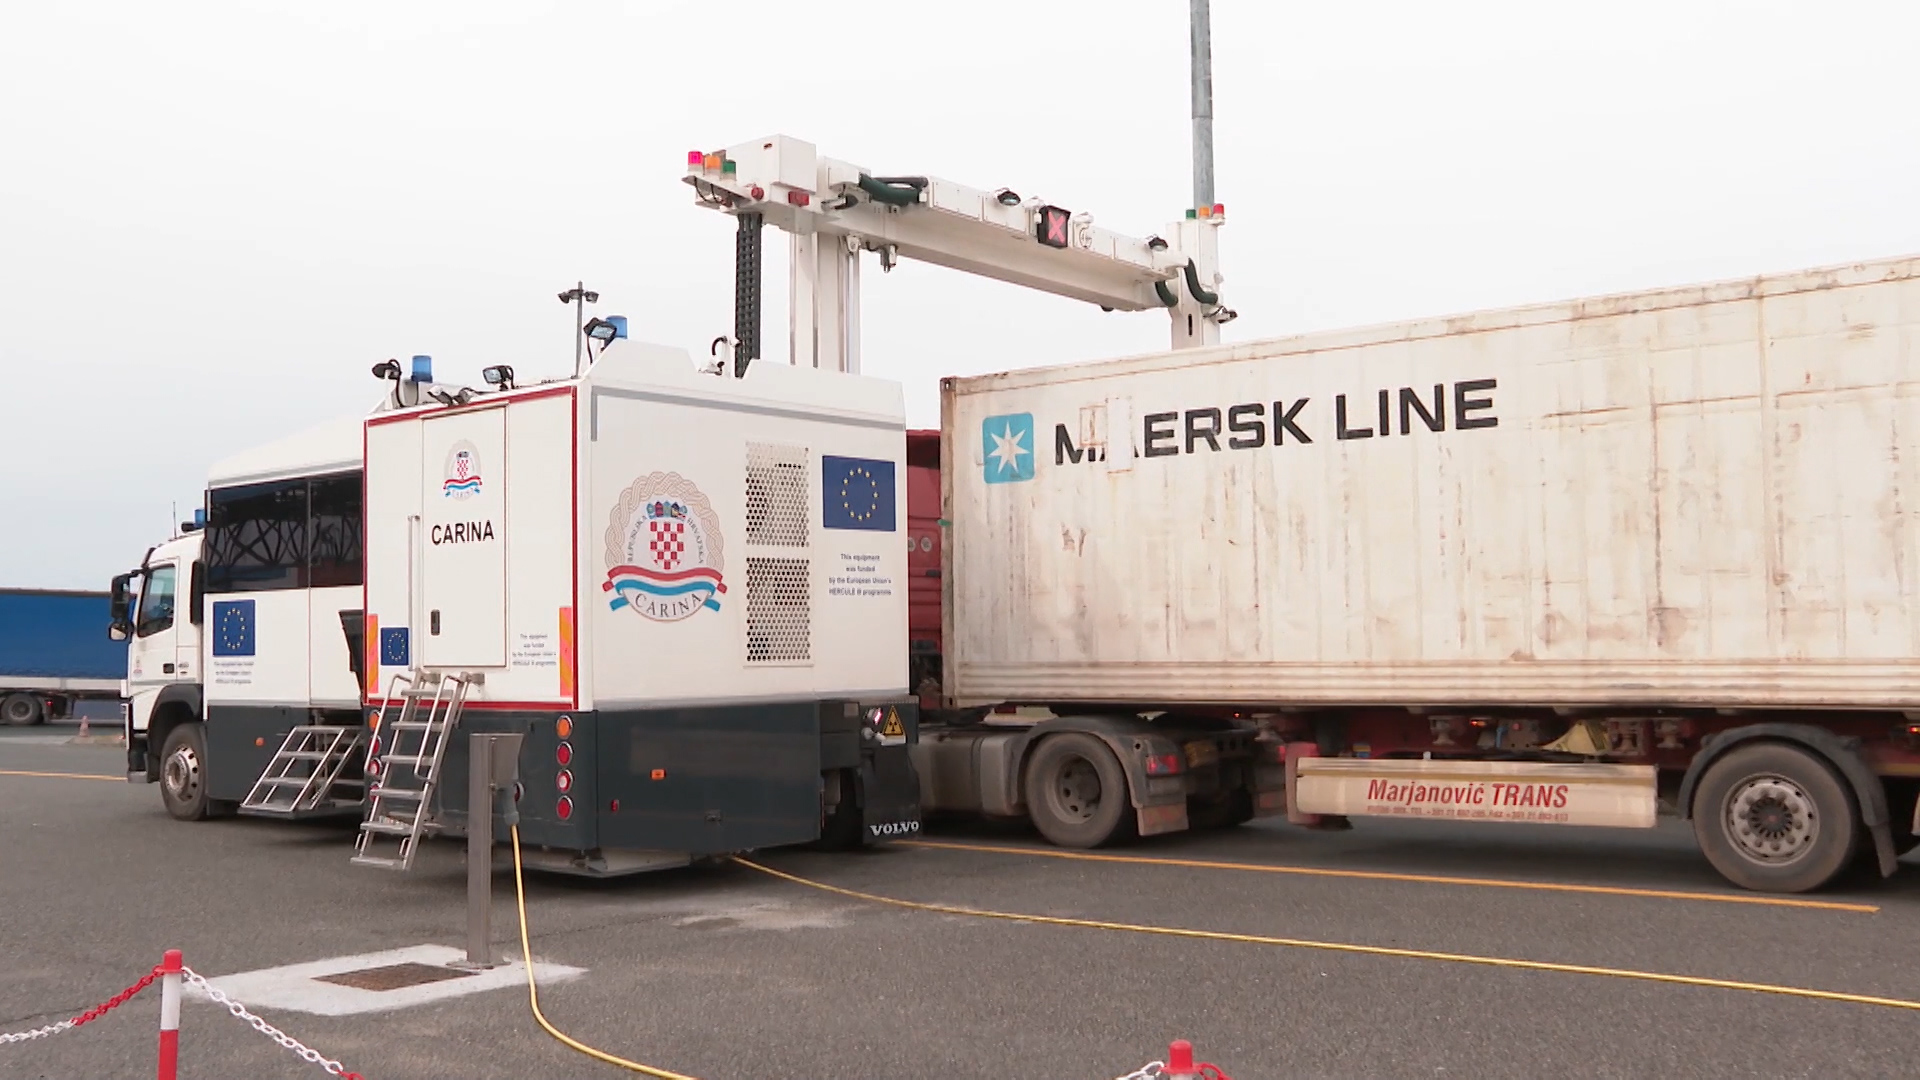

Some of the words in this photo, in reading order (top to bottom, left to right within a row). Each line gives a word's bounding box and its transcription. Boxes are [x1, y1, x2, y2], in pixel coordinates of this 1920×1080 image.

[1054, 397, 1314, 467] MERSK
[1334, 378, 1498, 441] LINE
[431, 519, 494, 546] CARINA
[635, 592, 702, 618] CARINA
[1367, 779, 1485, 806] Marjanović
[1491, 783, 1569, 808] TRANS
[869, 821, 919, 837] VOLVO
